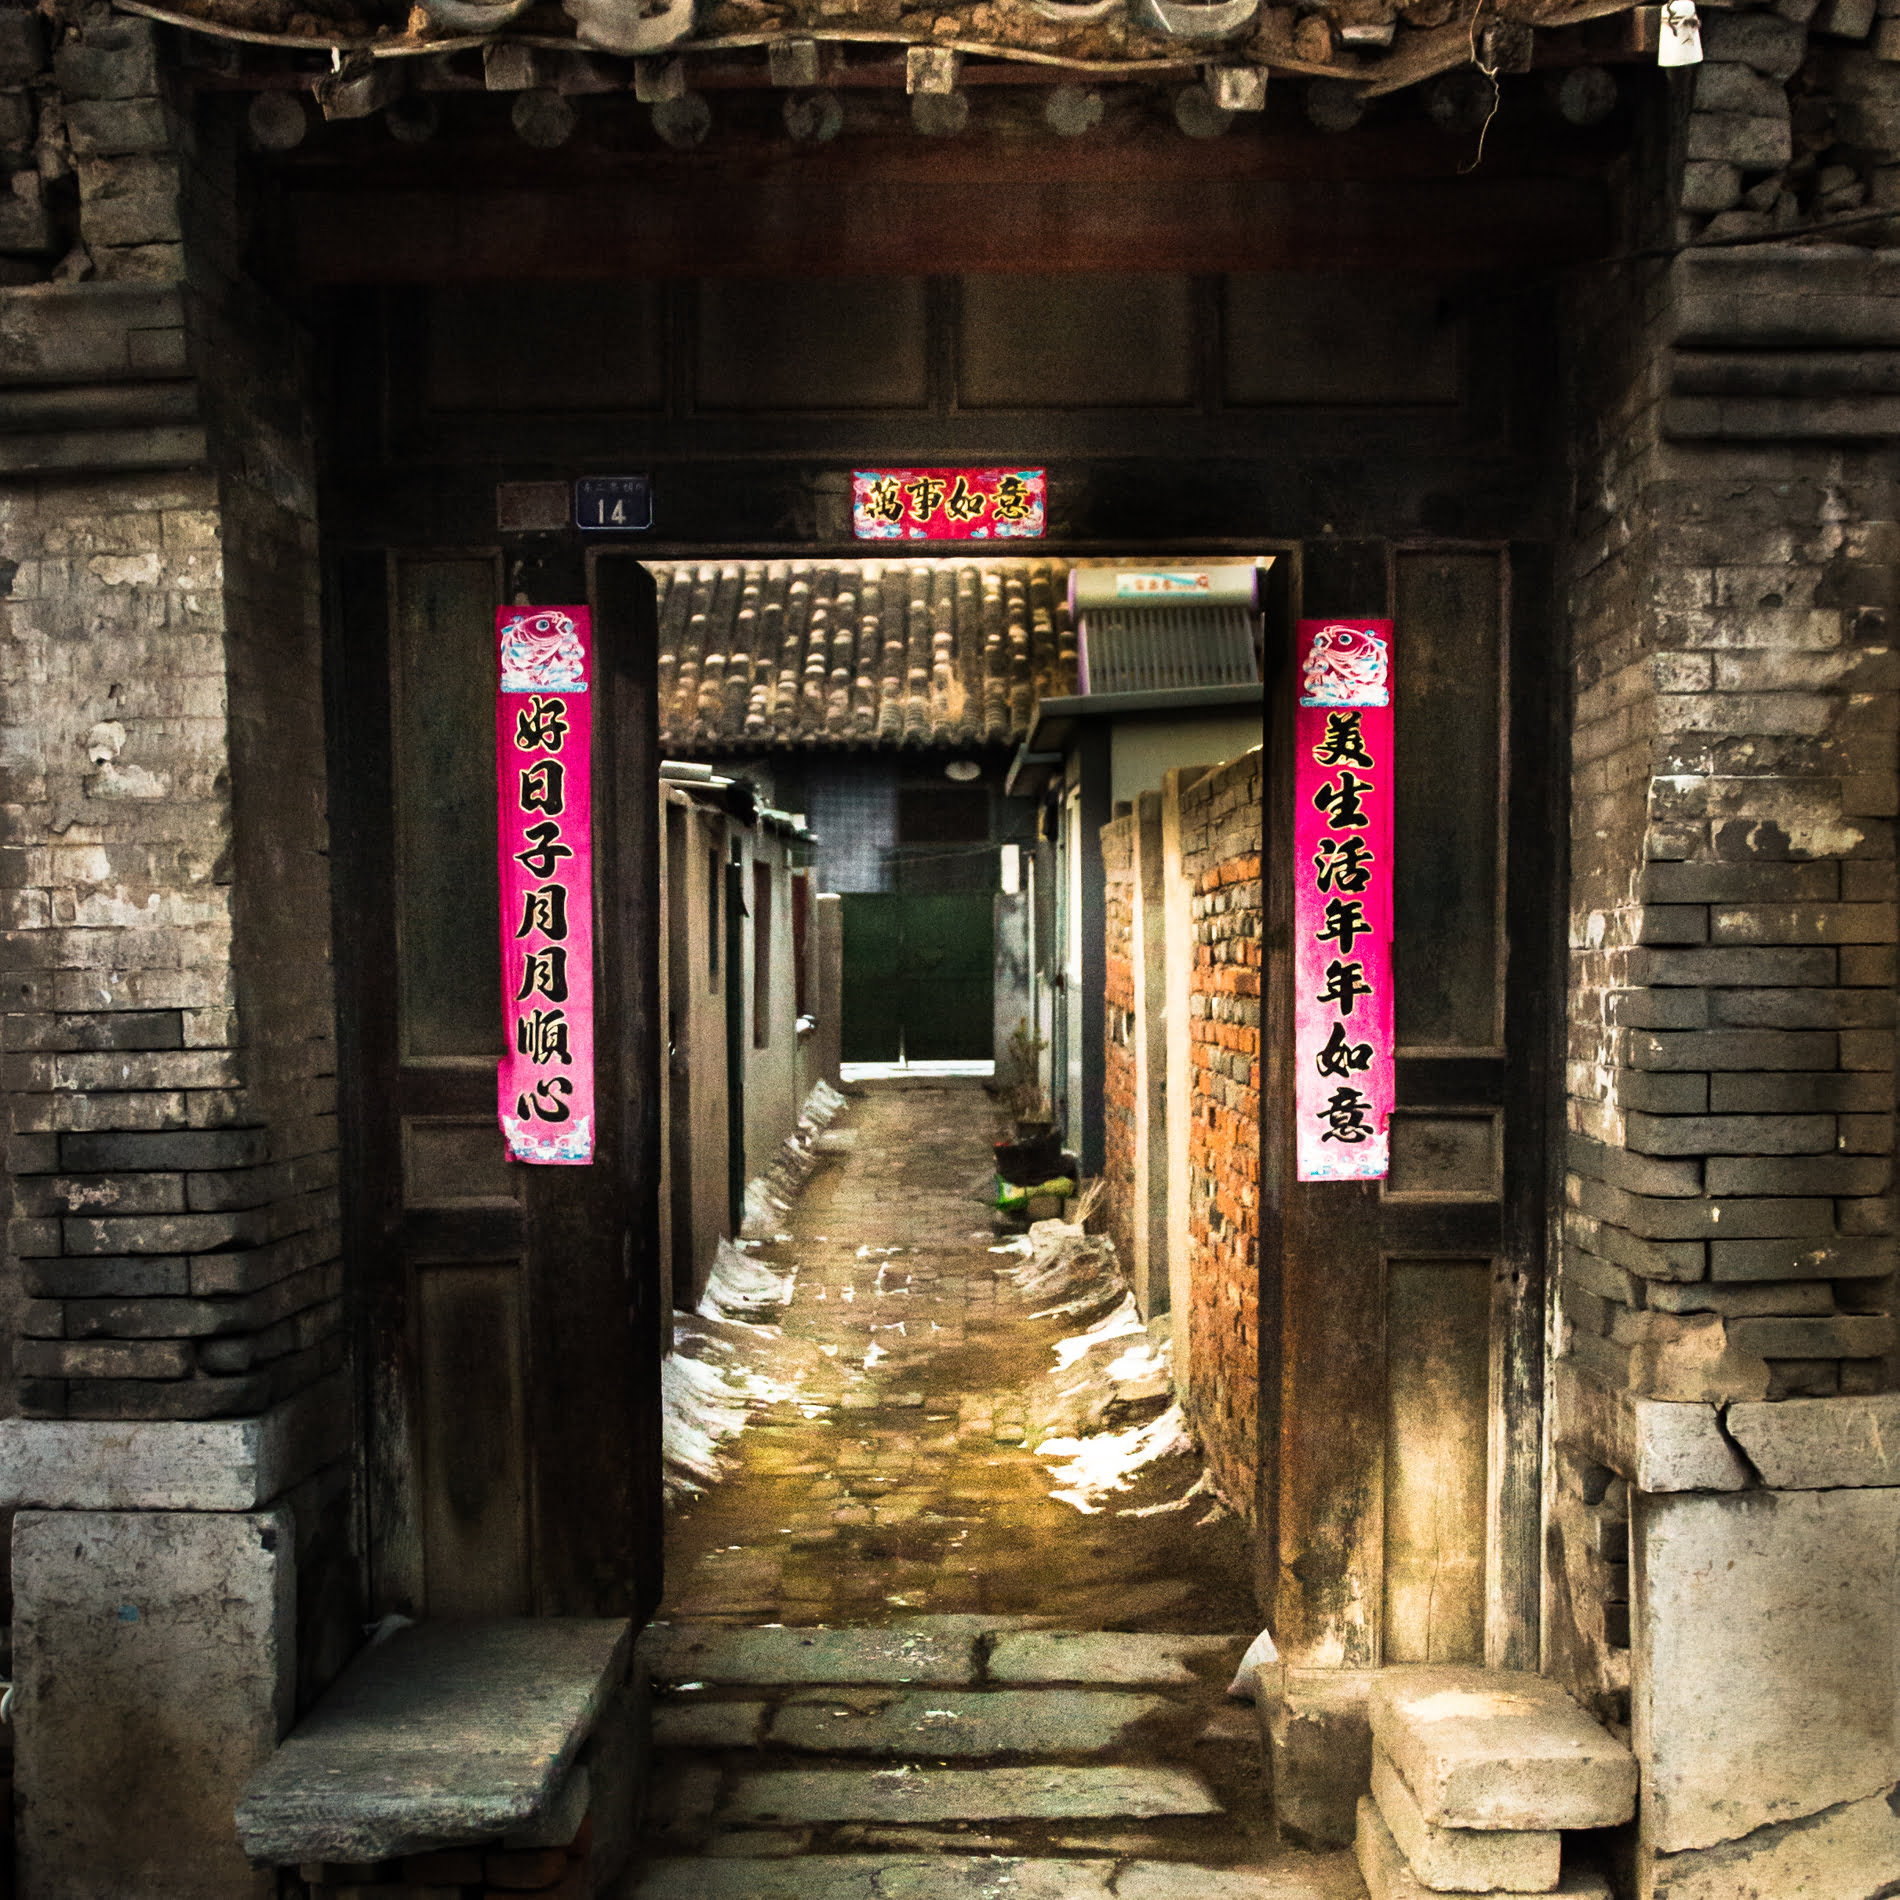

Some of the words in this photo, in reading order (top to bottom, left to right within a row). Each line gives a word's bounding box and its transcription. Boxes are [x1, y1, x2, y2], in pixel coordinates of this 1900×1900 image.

[598, 498, 627, 525] 14
[865, 476, 1030, 521] 萬事如意
[513, 694, 574, 1124] 好日子月月順心
[1312, 710, 1375, 1144] 美生活年年如意
